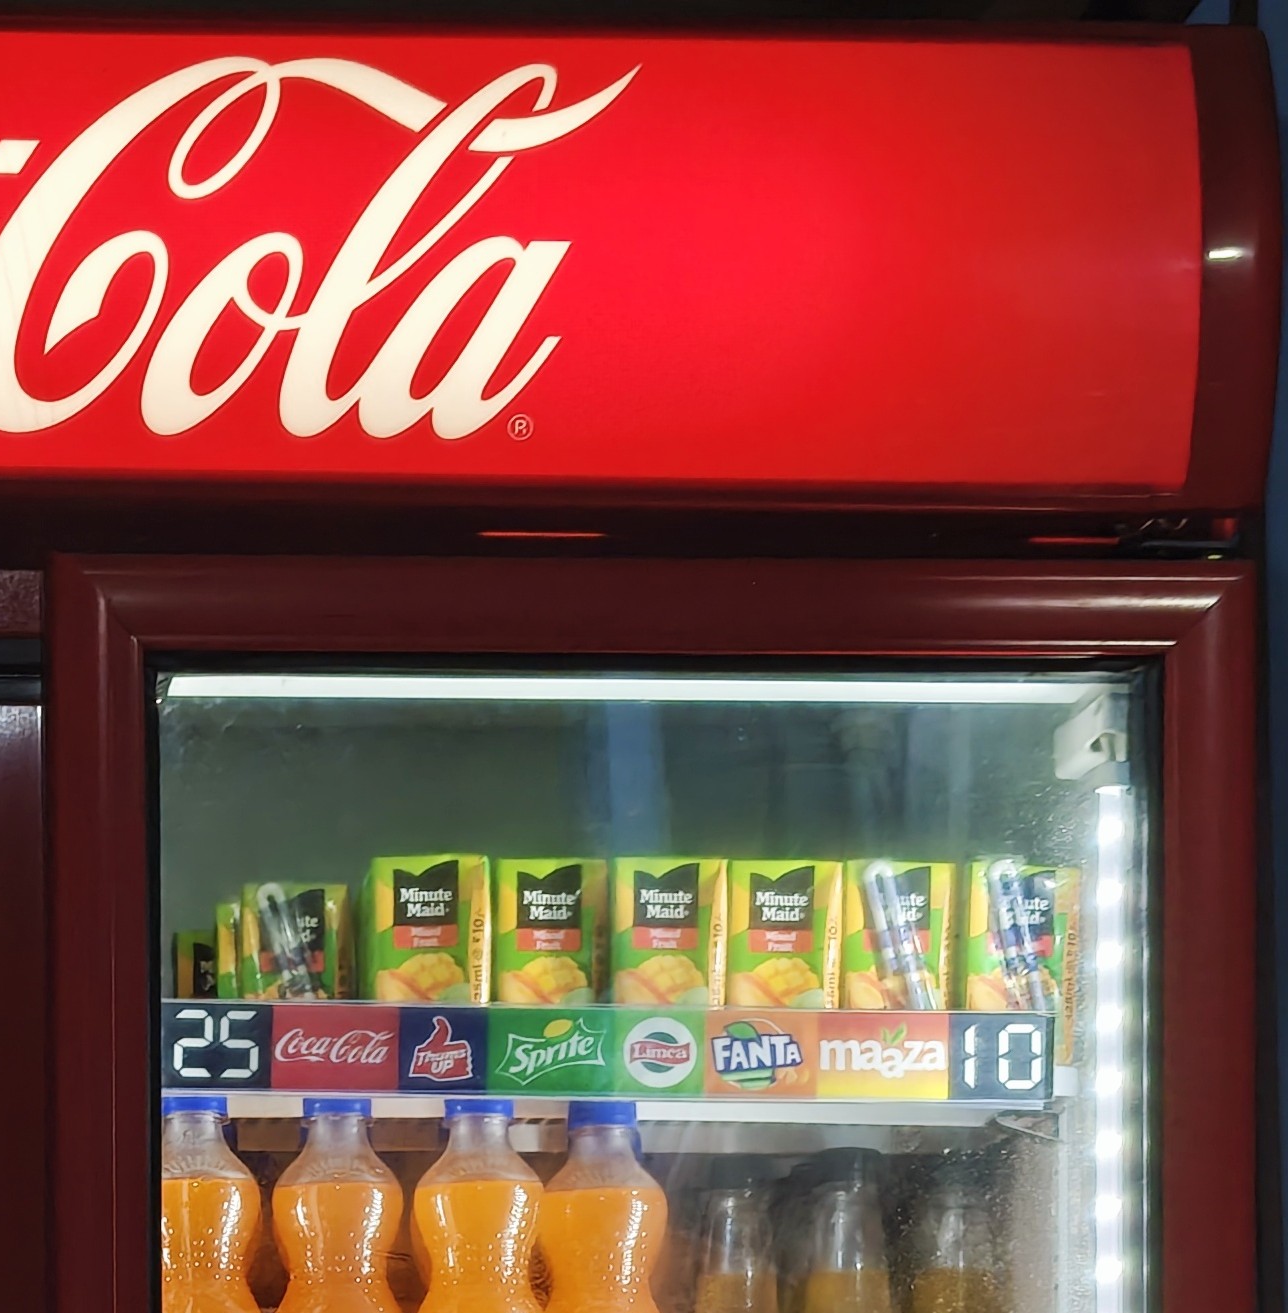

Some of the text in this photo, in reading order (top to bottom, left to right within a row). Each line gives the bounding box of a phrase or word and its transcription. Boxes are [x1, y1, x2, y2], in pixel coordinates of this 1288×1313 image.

[399, 888, 453, 903] Minute
[523, 889, 575, 906] Minute
[639, 889, 693, 905] Minute
[754, 891, 809, 907] Minute
[406, 903, 445, 918] Maid
[529, 906, 568, 921] Maid
[645, 904, 686, 920] Maid
[762, 906, 801, 921] Maid
[173, 1009, 259, 1079] 25
[275, 1028, 392, 1066] Coca-Cola
[630, 1042, 689, 1061] Limca
[511, 1033, 594, 1076] Sprite
[712, 1037, 802, 1070] FANTA
[819, 1037, 948, 1079] maaza
[963, 1023, 1042, 1090] 10
